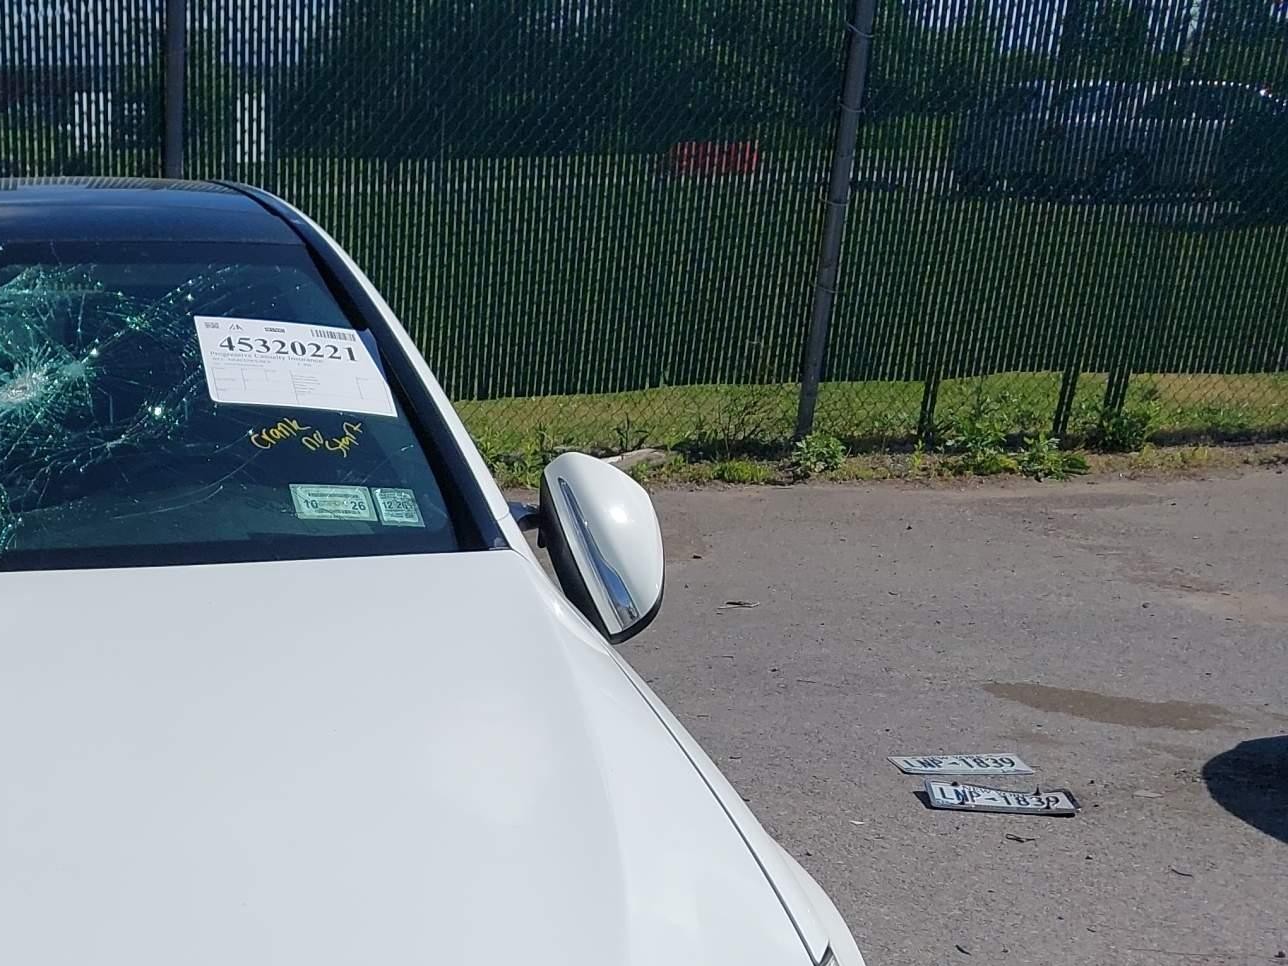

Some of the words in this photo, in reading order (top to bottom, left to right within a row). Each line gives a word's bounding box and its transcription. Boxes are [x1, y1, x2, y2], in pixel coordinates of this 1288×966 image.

[219, 336, 358, 362] 45320221
[250, 417, 312, 449] Crank
[350, 500, 367, 511] 26
